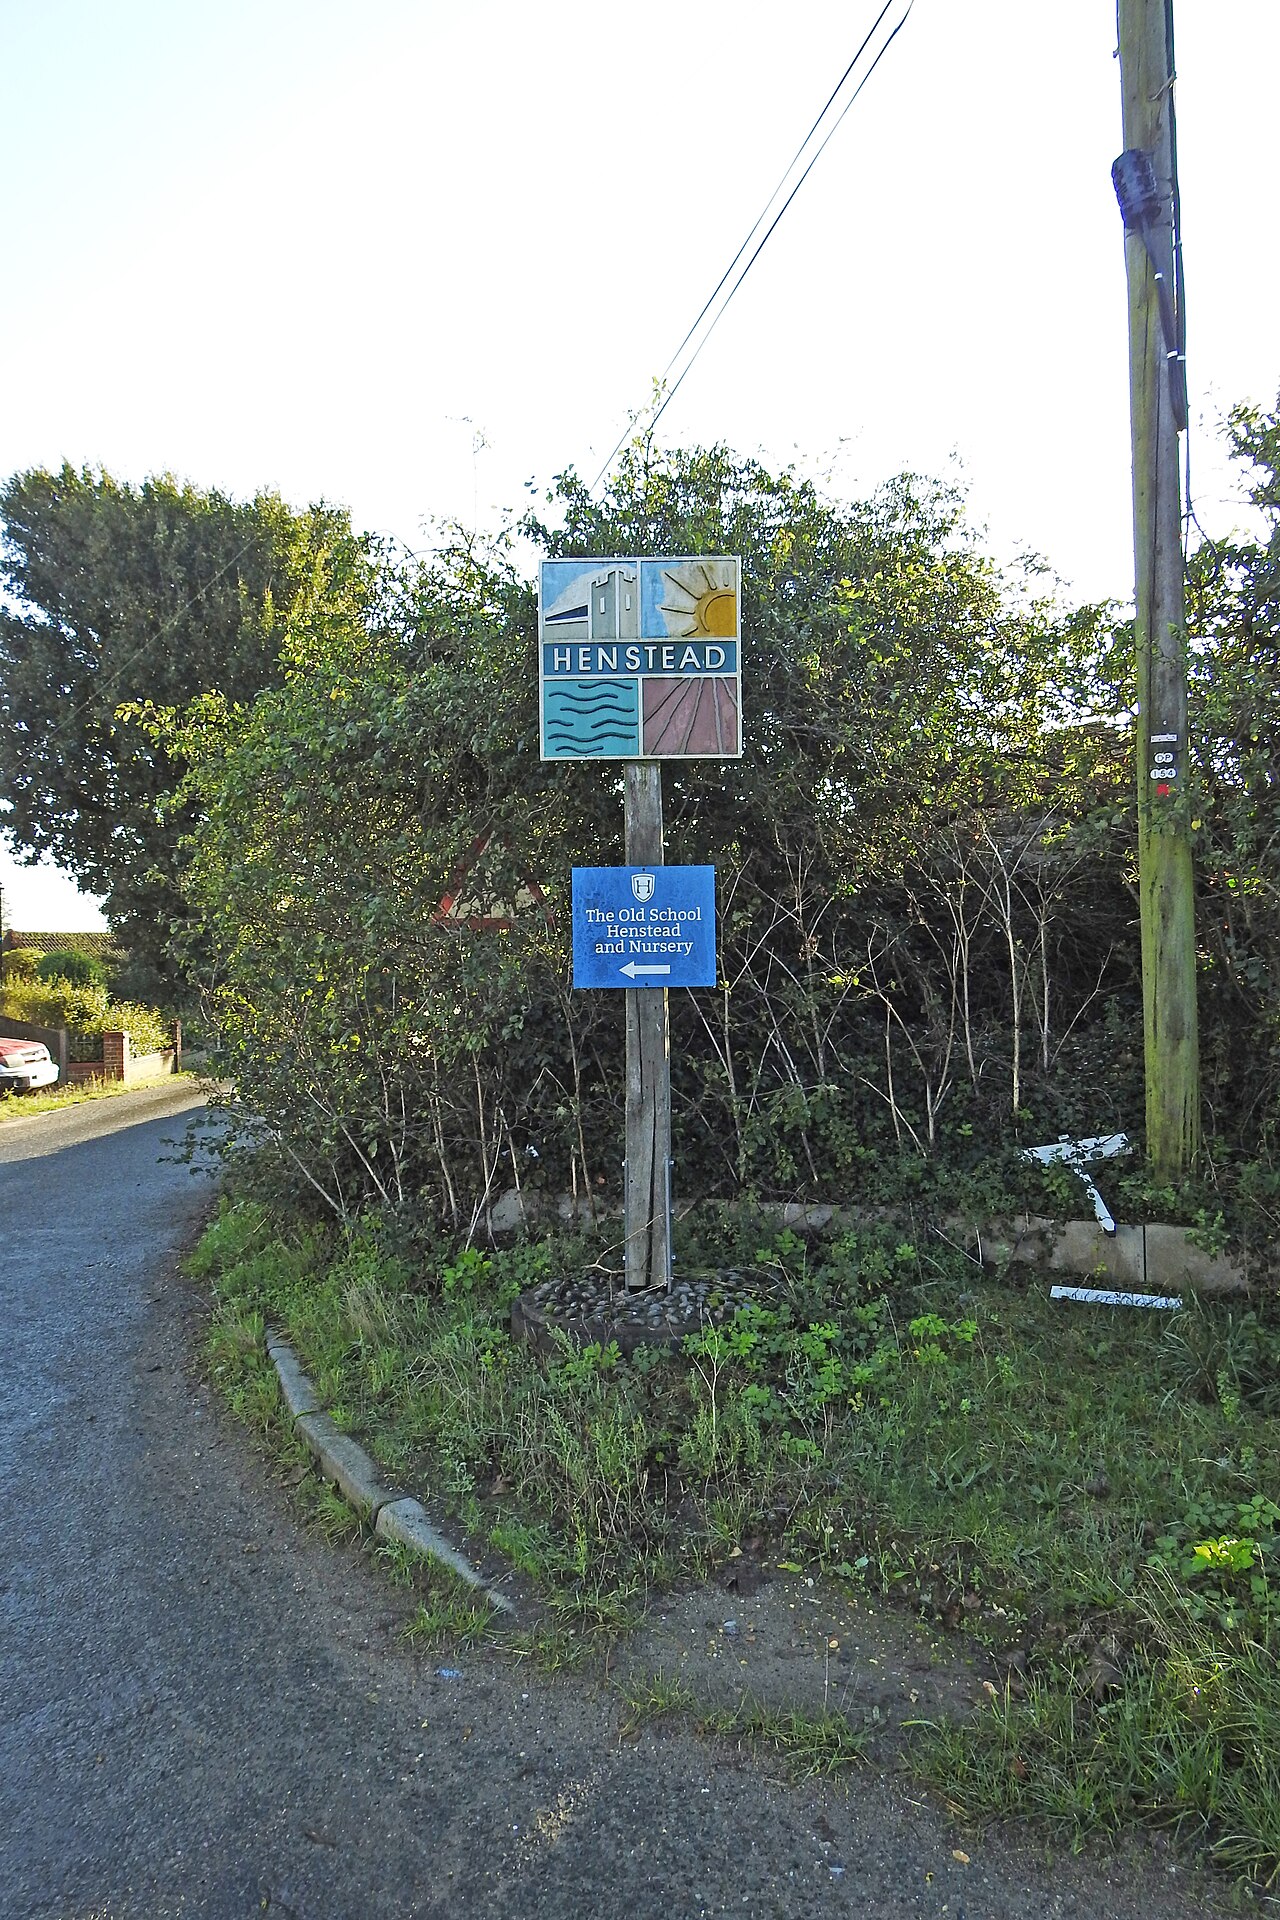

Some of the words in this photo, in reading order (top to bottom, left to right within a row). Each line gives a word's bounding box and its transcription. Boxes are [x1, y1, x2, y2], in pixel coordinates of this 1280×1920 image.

[553, 645, 726, 671] HENSTEAD
[1156, 753, 1172, 763] DP
[1152, 769, 1175, 778] 154
[636, 880, 651, 894] H
[586, 908, 614, 922] The
[618, 908, 646, 922] Old
[649, 907, 702, 921] School
[606, 923, 681, 937] Henstead
[595, 940, 625, 954] and
[629, 940, 693, 956] Nursery
